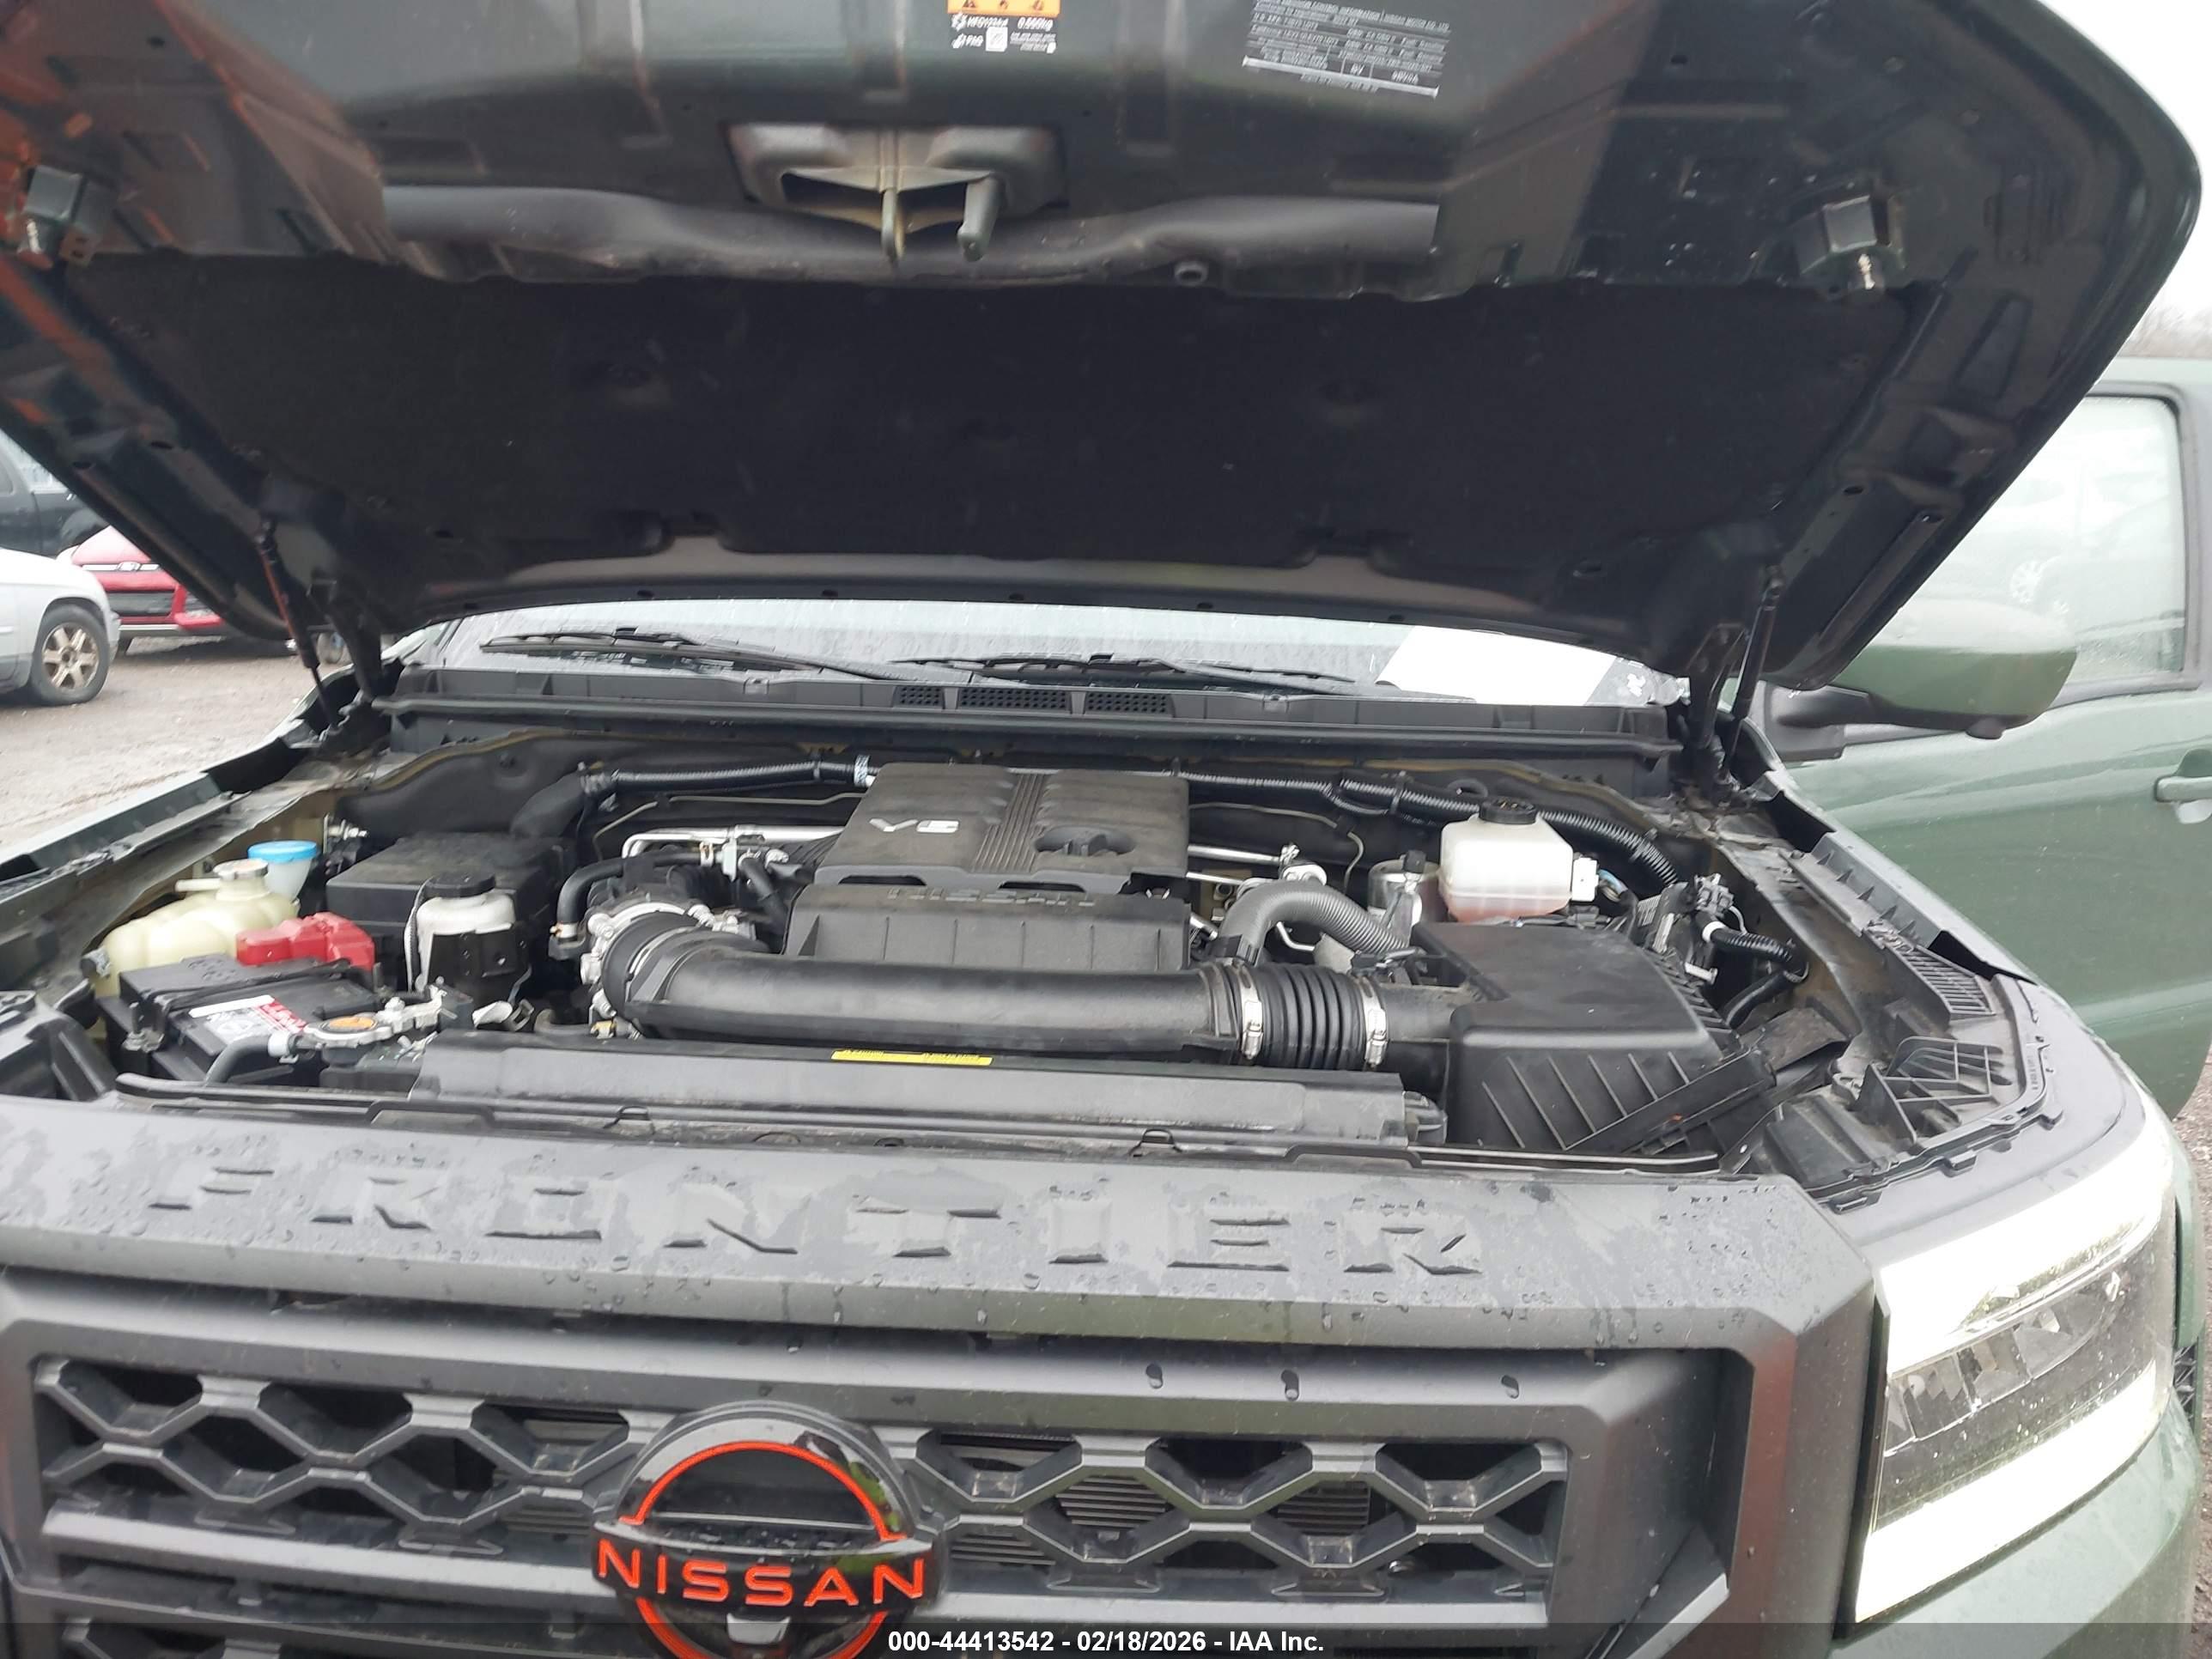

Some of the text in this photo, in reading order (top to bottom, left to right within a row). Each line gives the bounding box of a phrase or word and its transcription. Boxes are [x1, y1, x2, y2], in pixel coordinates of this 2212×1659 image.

[869, 817, 960, 834] V6
[148, 1157, 1483, 1276] FRONTIER
[599, 1539, 925, 1607] NISSAN
